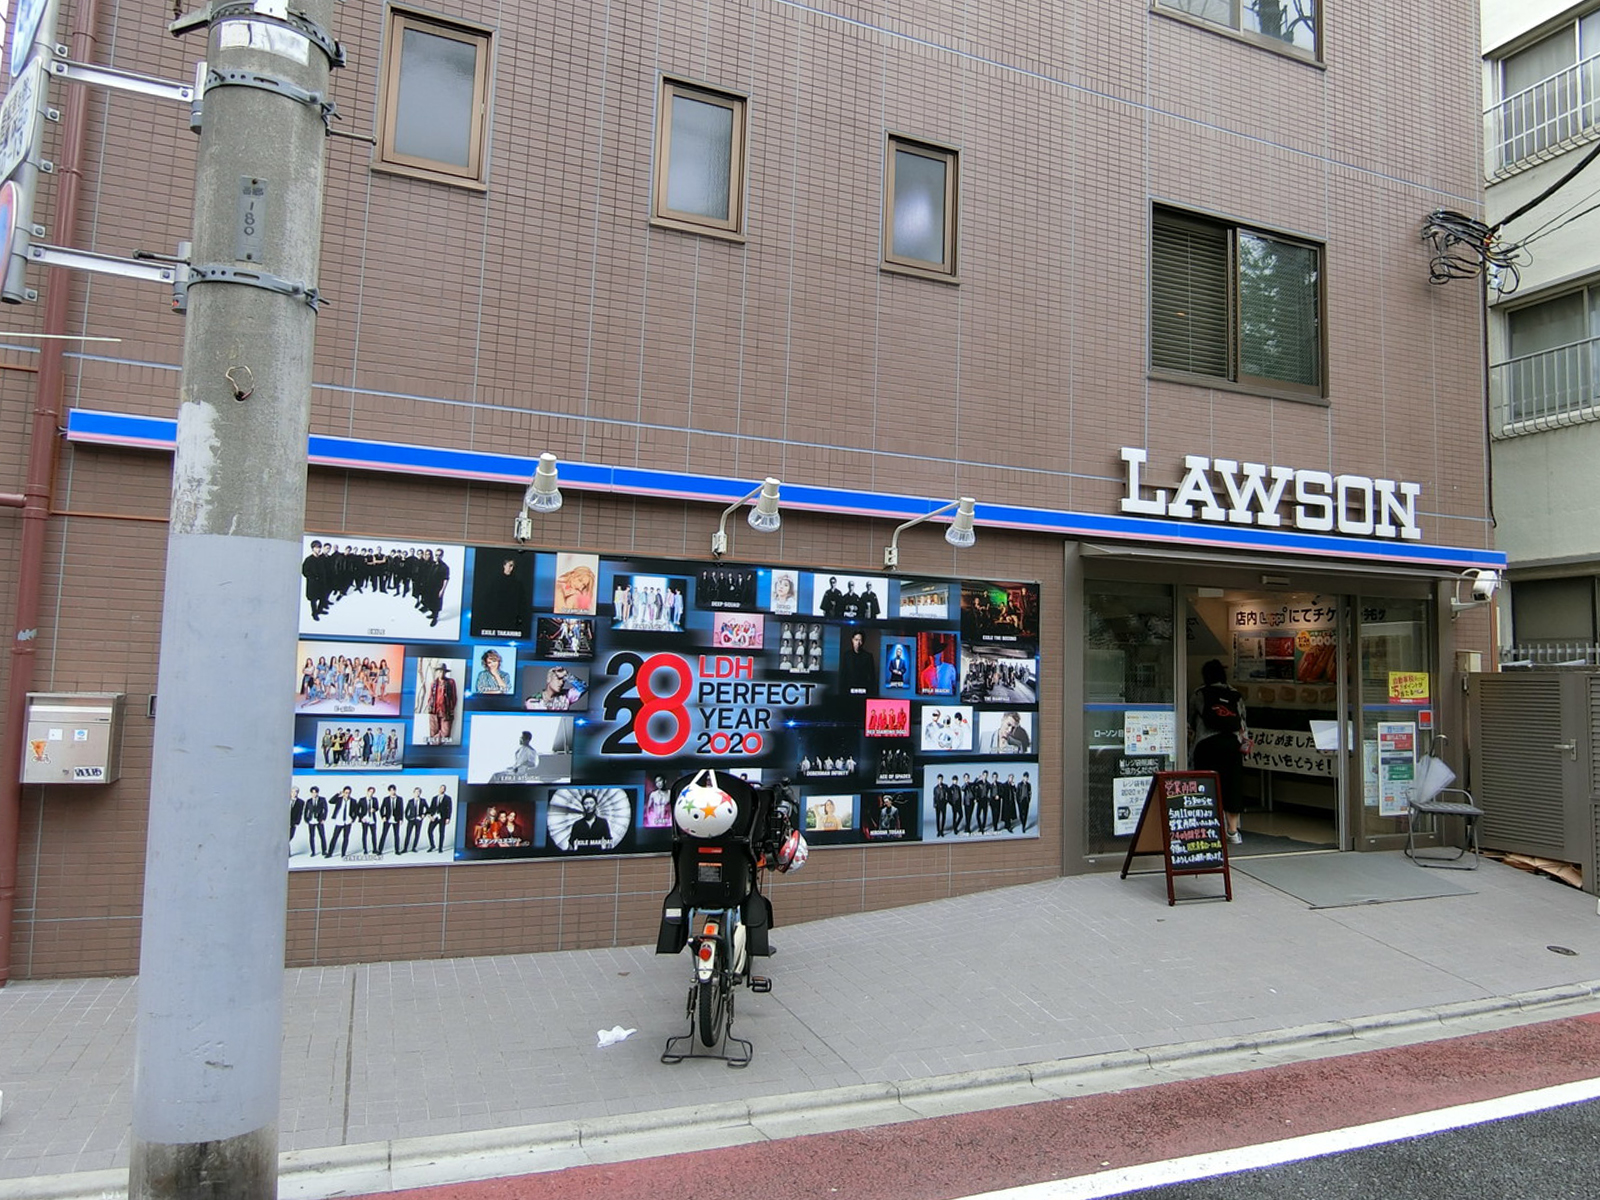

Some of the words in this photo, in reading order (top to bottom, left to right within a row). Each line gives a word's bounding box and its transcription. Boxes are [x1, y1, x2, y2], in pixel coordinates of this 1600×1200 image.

[244, 201, 255, 235] 180
[1120, 446, 1422, 540] LAWSON
[698, 654, 754, 680] LDH
[697, 681, 816, 705] PERFECT
[699, 707, 772, 730] YEAR
[696, 732, 763, 755] 2020
